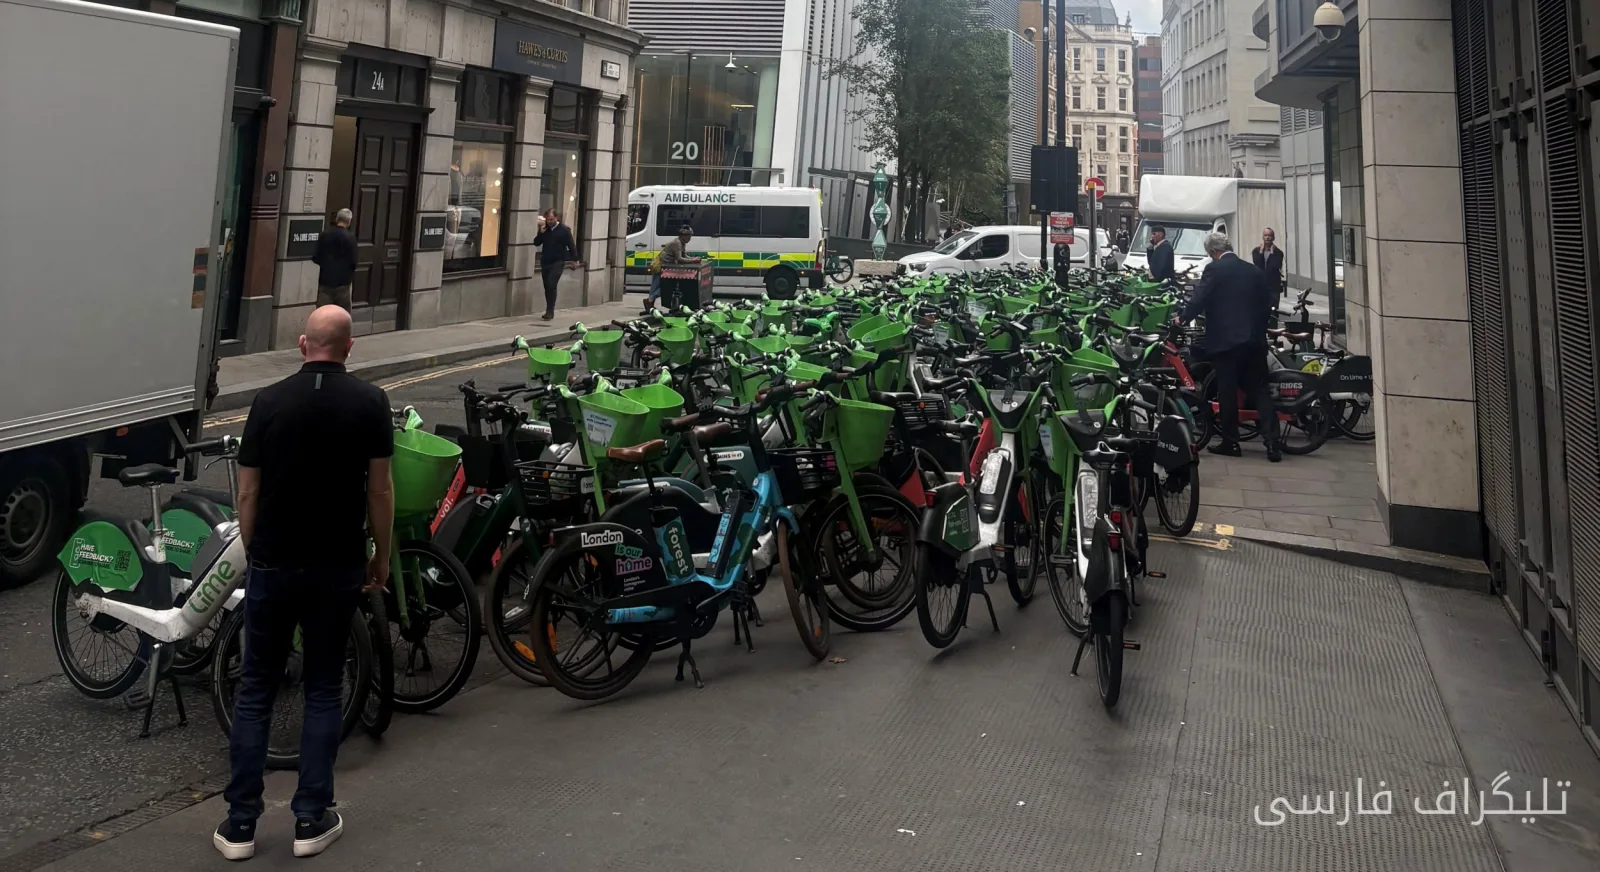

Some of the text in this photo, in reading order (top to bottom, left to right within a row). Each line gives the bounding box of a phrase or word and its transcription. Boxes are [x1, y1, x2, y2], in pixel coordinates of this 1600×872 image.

[518, 40, 542, 57] HAWES
[546, 47, 569, 63] CURTIS
[371, 71, 385, 91] 24A
[671, 141, 699, 160] 20
[269, 173, 276, 182] 24
[664, 193, 737, 203] AMBULANCE
[1280, 382, 1304, 390] RIDES
[162, 530, 175, 538] AVE
[582, 530, 624, 547] London
[80, 544, 96, 552] HAVE
[615, 543, 643, 558] is our
[669, 526, 689, 575] forest
[79, 551, 114, 563] FEEDBACK?
[616, 557, 653, 575] home
